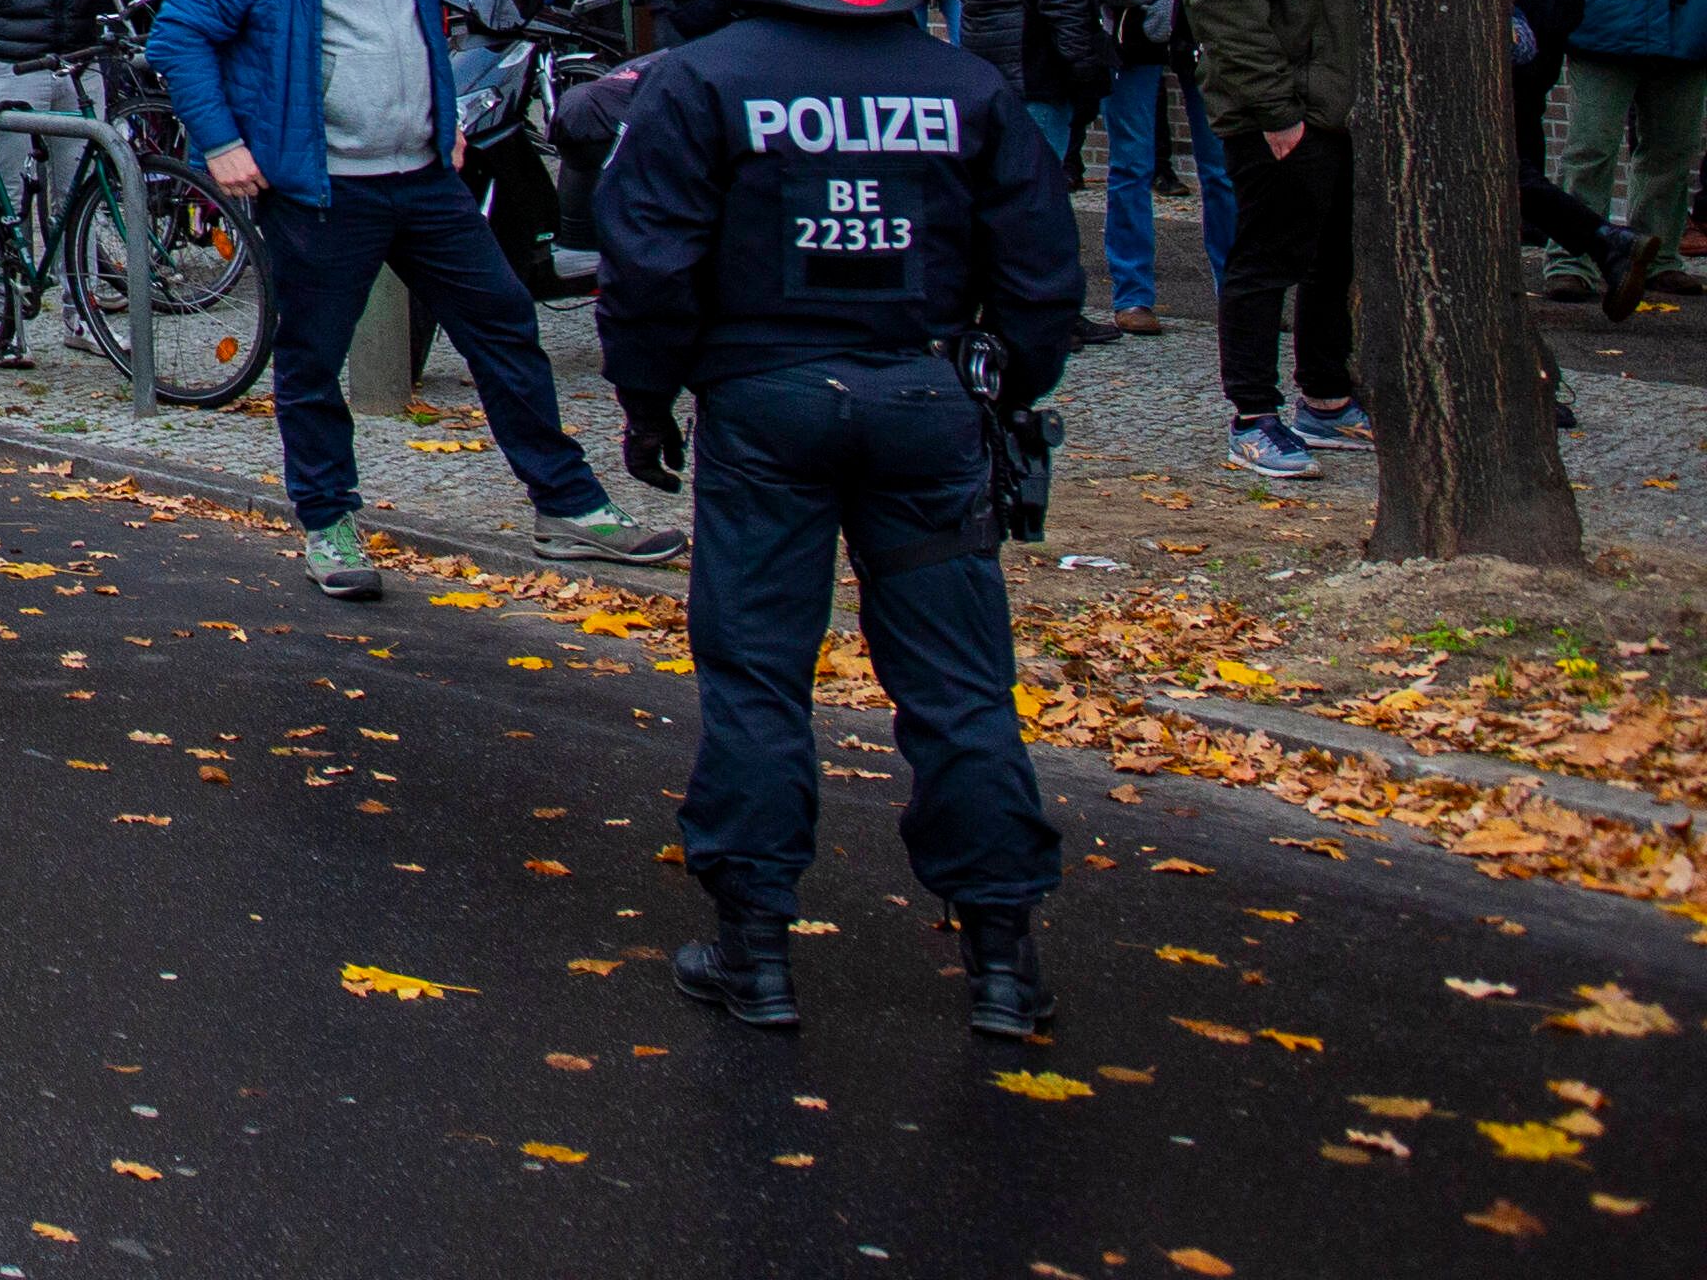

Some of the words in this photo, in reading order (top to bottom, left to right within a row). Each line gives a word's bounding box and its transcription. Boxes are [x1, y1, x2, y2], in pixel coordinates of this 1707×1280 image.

[744, 96, 960, 153] POLIZEI
[828, 179, 881, 212] BE
[795, 217, 912, 251] 22313
